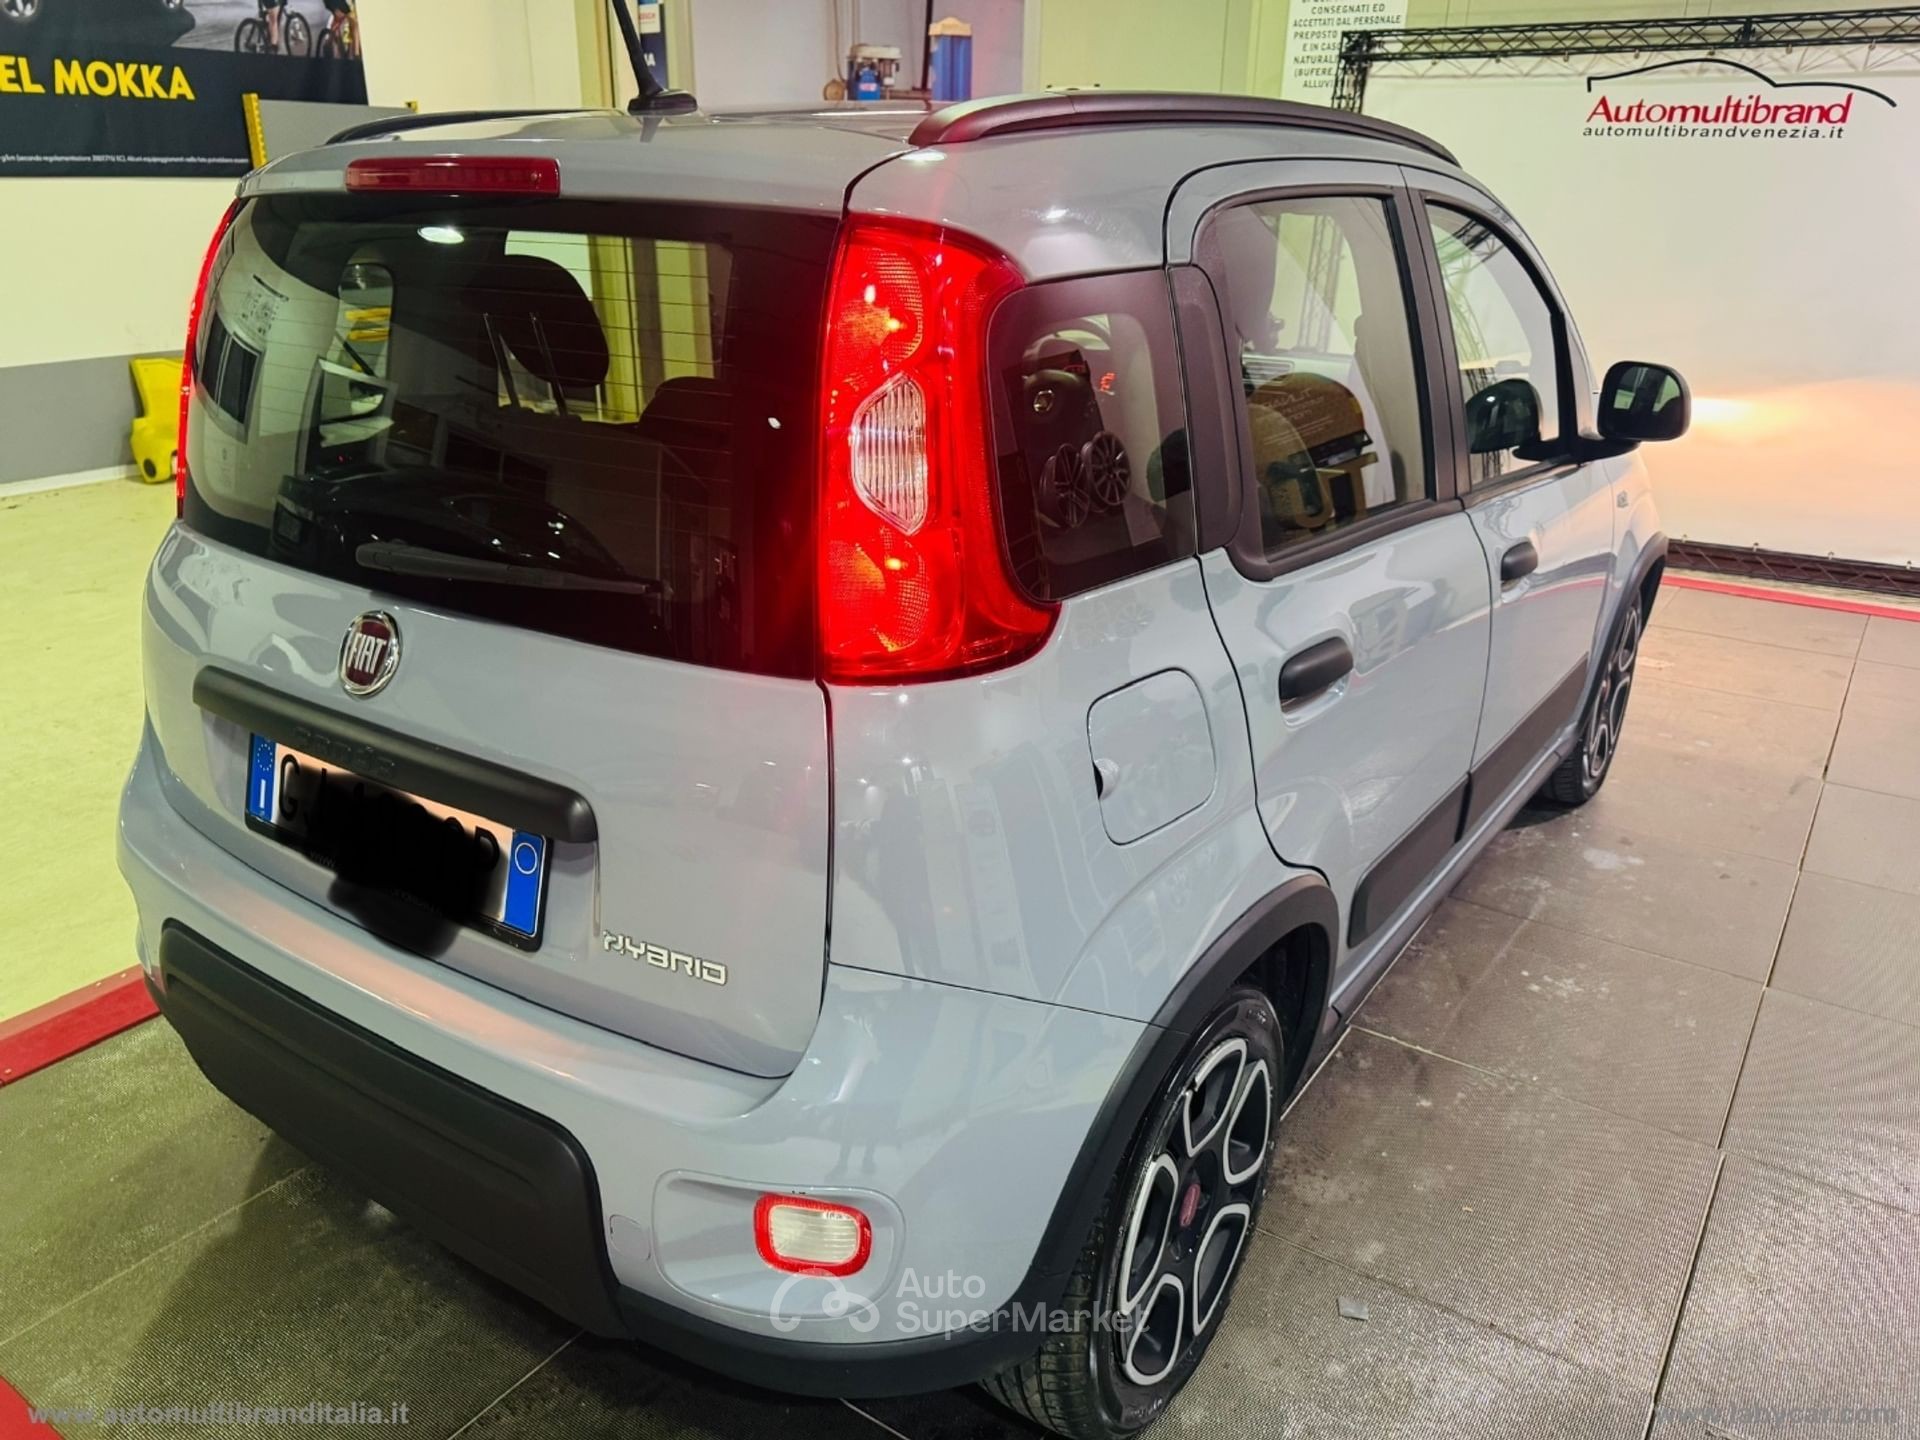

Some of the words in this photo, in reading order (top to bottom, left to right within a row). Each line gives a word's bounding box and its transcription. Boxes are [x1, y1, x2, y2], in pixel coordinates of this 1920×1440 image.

[1311, 4, 1370, 14] CONSEGNATI
[1372, 3, 1386, 12] ED
[1293, 18, 1334, 27] ACCETTATI
[1353, 15, 1401, 25] PERSONALE
[1293, 30, 1338, 40] PREPOSTO
[1309, 43, 1318, 52] IN
[54, 58, 195, 100] MOKKA
[1586, 92, 1854, 124] Automultibrand
[1583, 125, 1844, 139] automultibrandvenezia.it
[347, 632, 388, 674] FIAT
[602, 929, 728, 986] HYBRID
